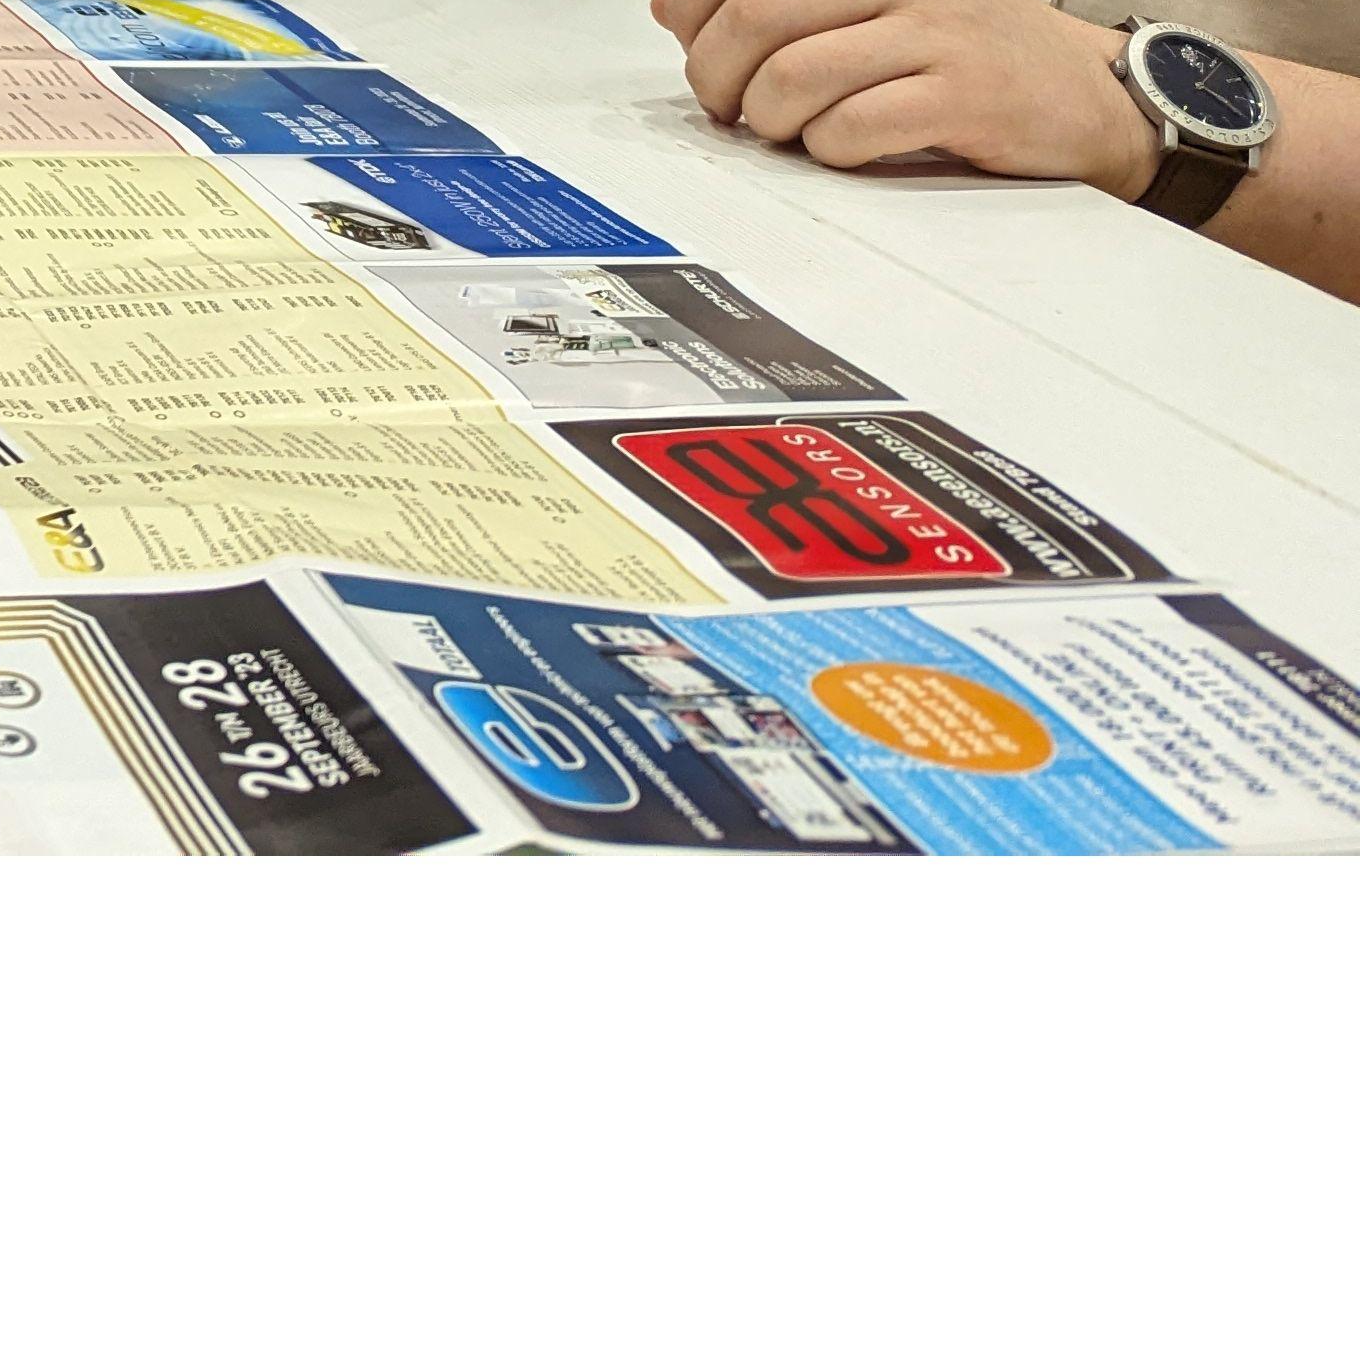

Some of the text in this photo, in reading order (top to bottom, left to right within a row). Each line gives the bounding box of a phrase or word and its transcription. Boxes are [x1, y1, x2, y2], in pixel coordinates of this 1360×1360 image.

[348, 159, 386, 180] TDK
[661, 341, 740, 390] Electronic
[688, 341, 766, 390] Solutions
[782, 432, 974, 563] SENSORS
[36, 505, 105, 574] E&A
[161, 659, 251, 710] 28
[248, 679, 350, 787] SEPTEMBER
[218, 742, 315, 799] 26
